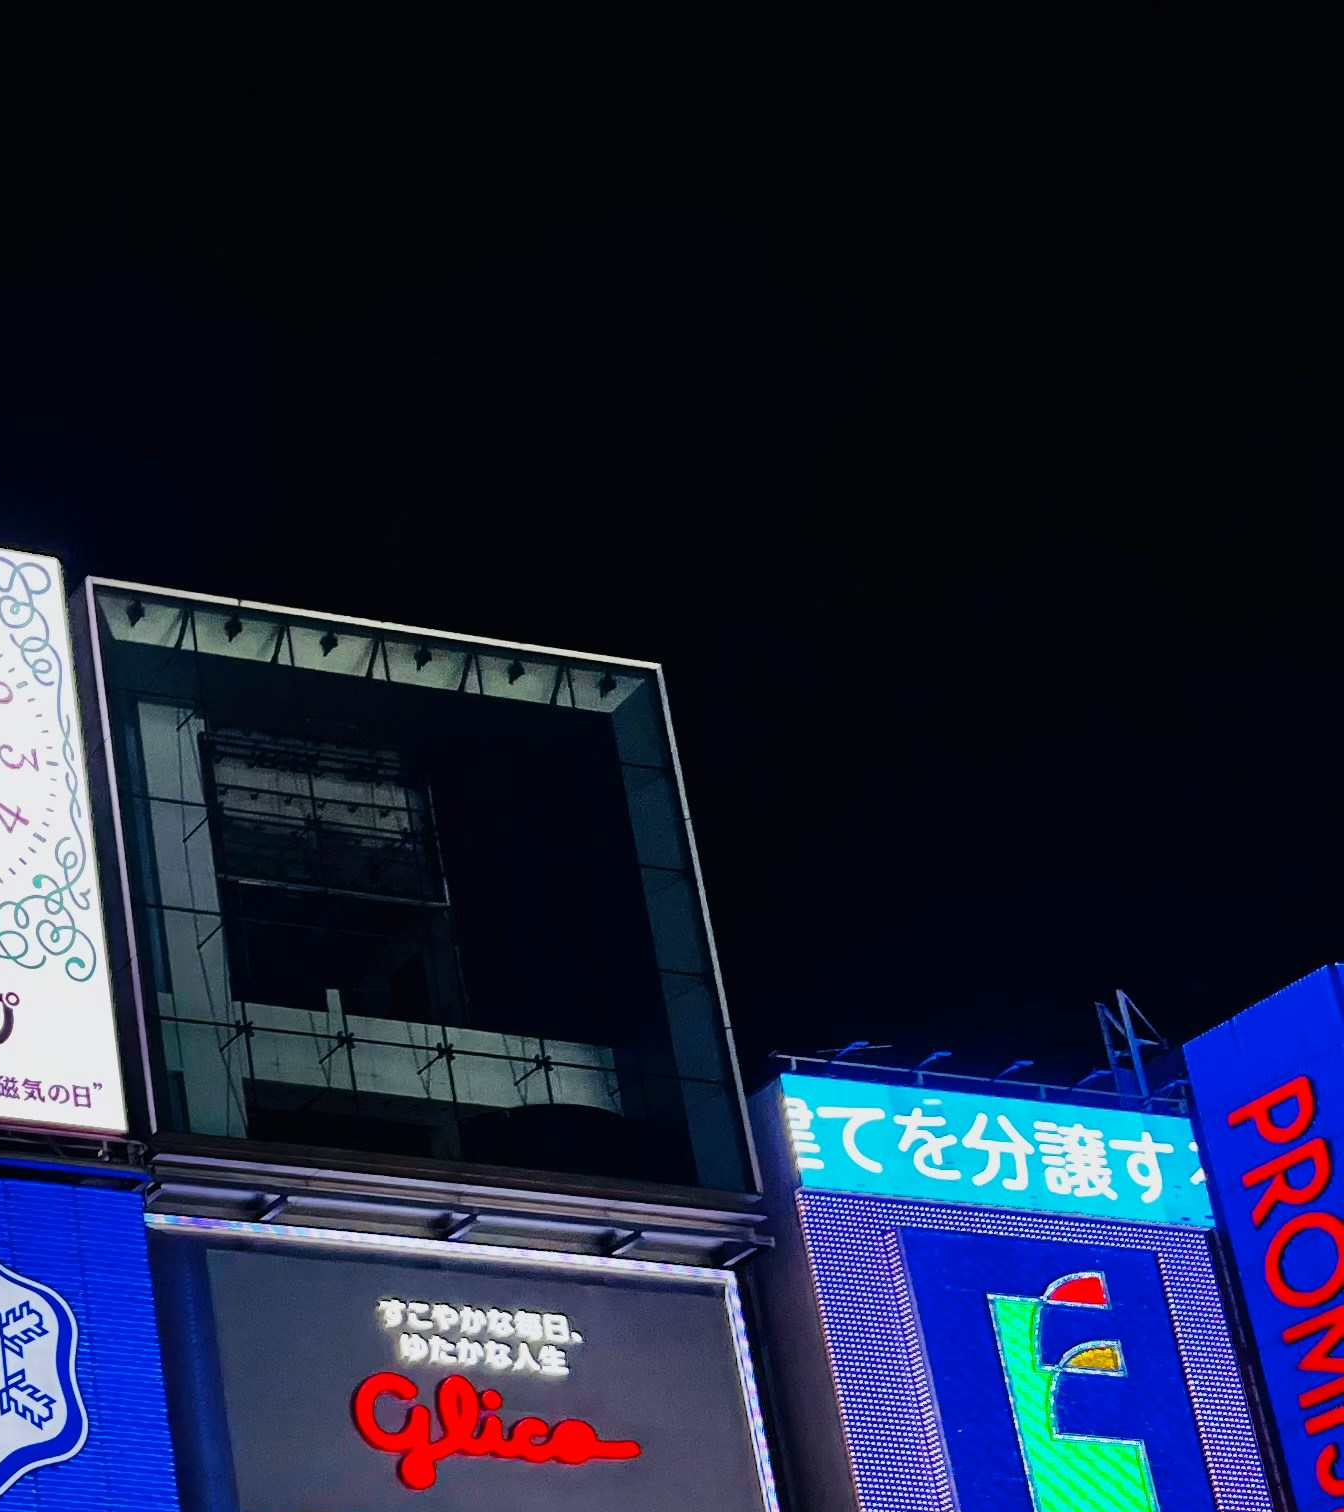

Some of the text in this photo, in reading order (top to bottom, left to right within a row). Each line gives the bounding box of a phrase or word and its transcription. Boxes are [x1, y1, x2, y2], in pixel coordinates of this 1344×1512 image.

[376, 1298, 585, 1344] すこやかな毎日、
[399, 1332, 570, 1377] ゆたかな人生
[353, 1371, 641, 1491] Glico
